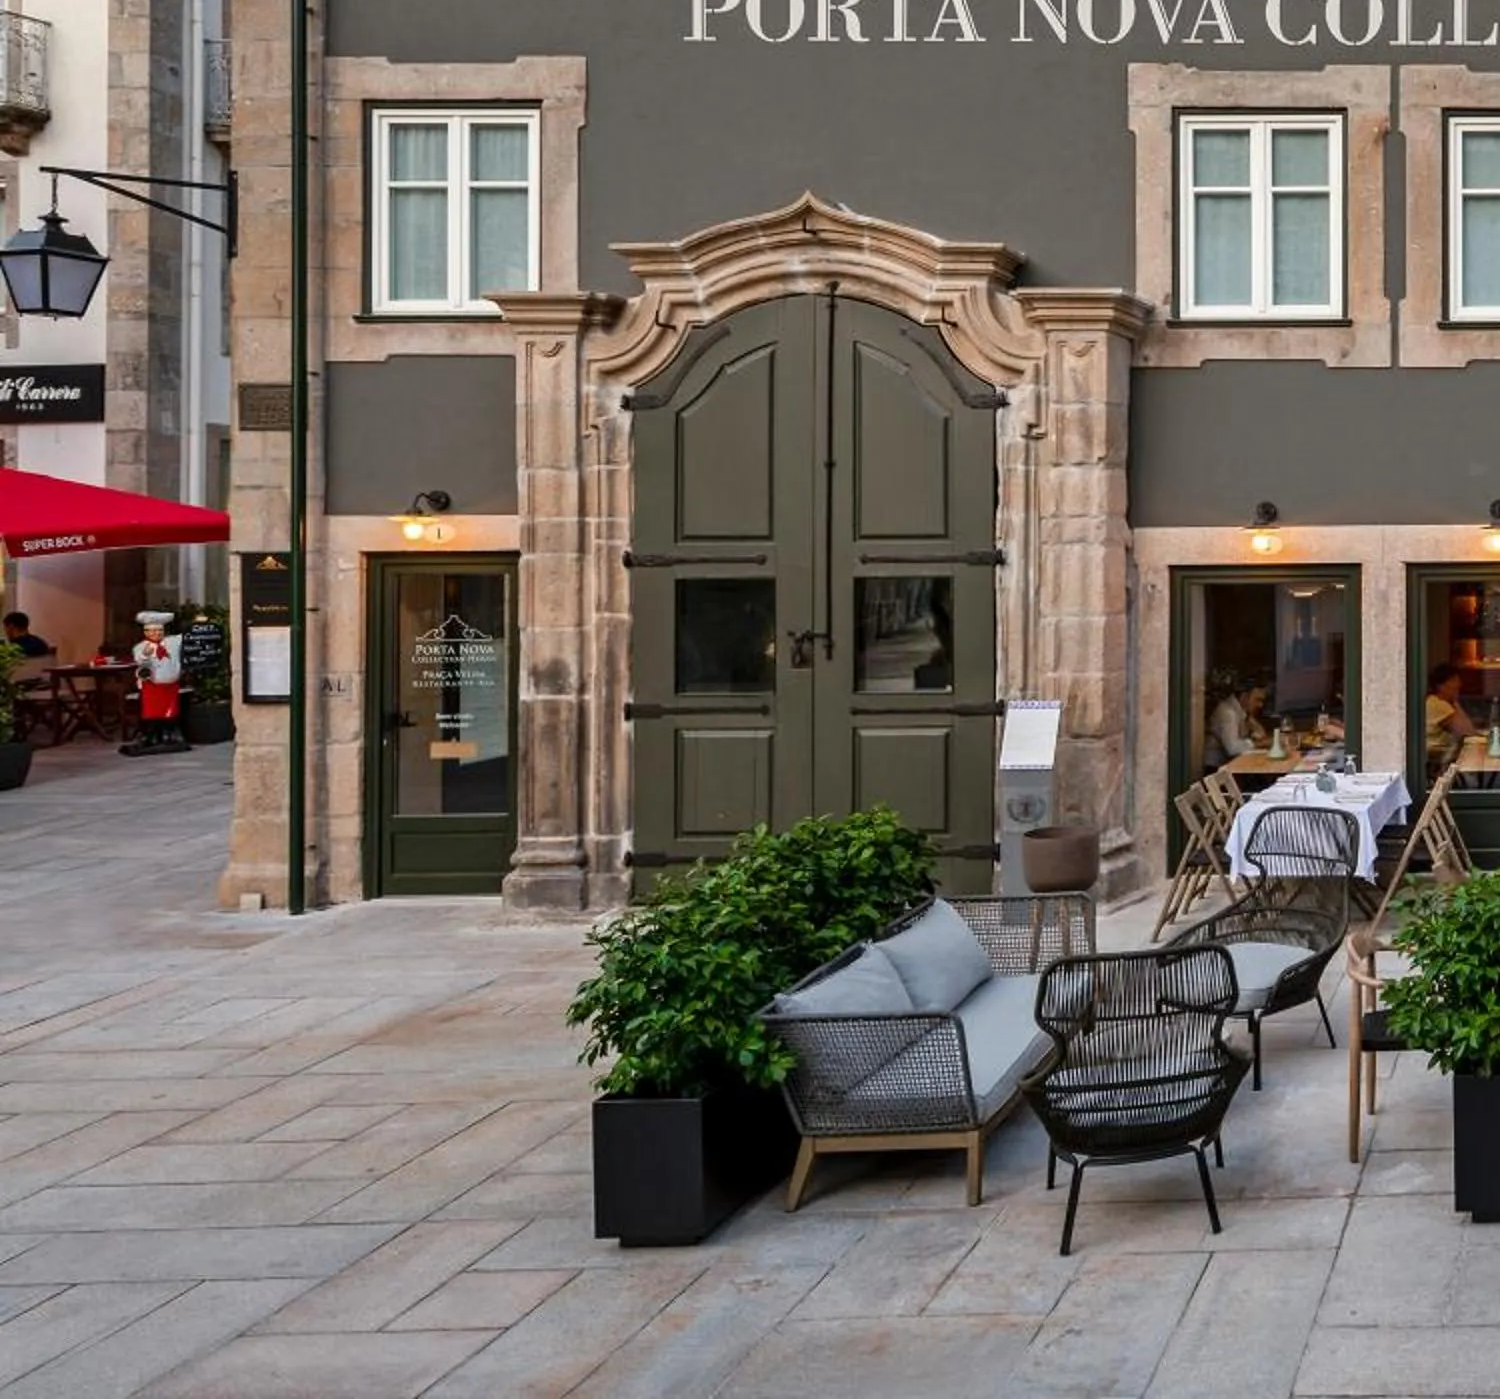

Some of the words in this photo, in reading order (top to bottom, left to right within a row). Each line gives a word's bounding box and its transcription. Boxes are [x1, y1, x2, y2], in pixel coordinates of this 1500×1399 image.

[23, 538, 55, 552] SUPER
[56, 536, 84, 548] BOCK
[415, 644, 455, 655] PORTA
[460, 643, 495, 654] NOVA
